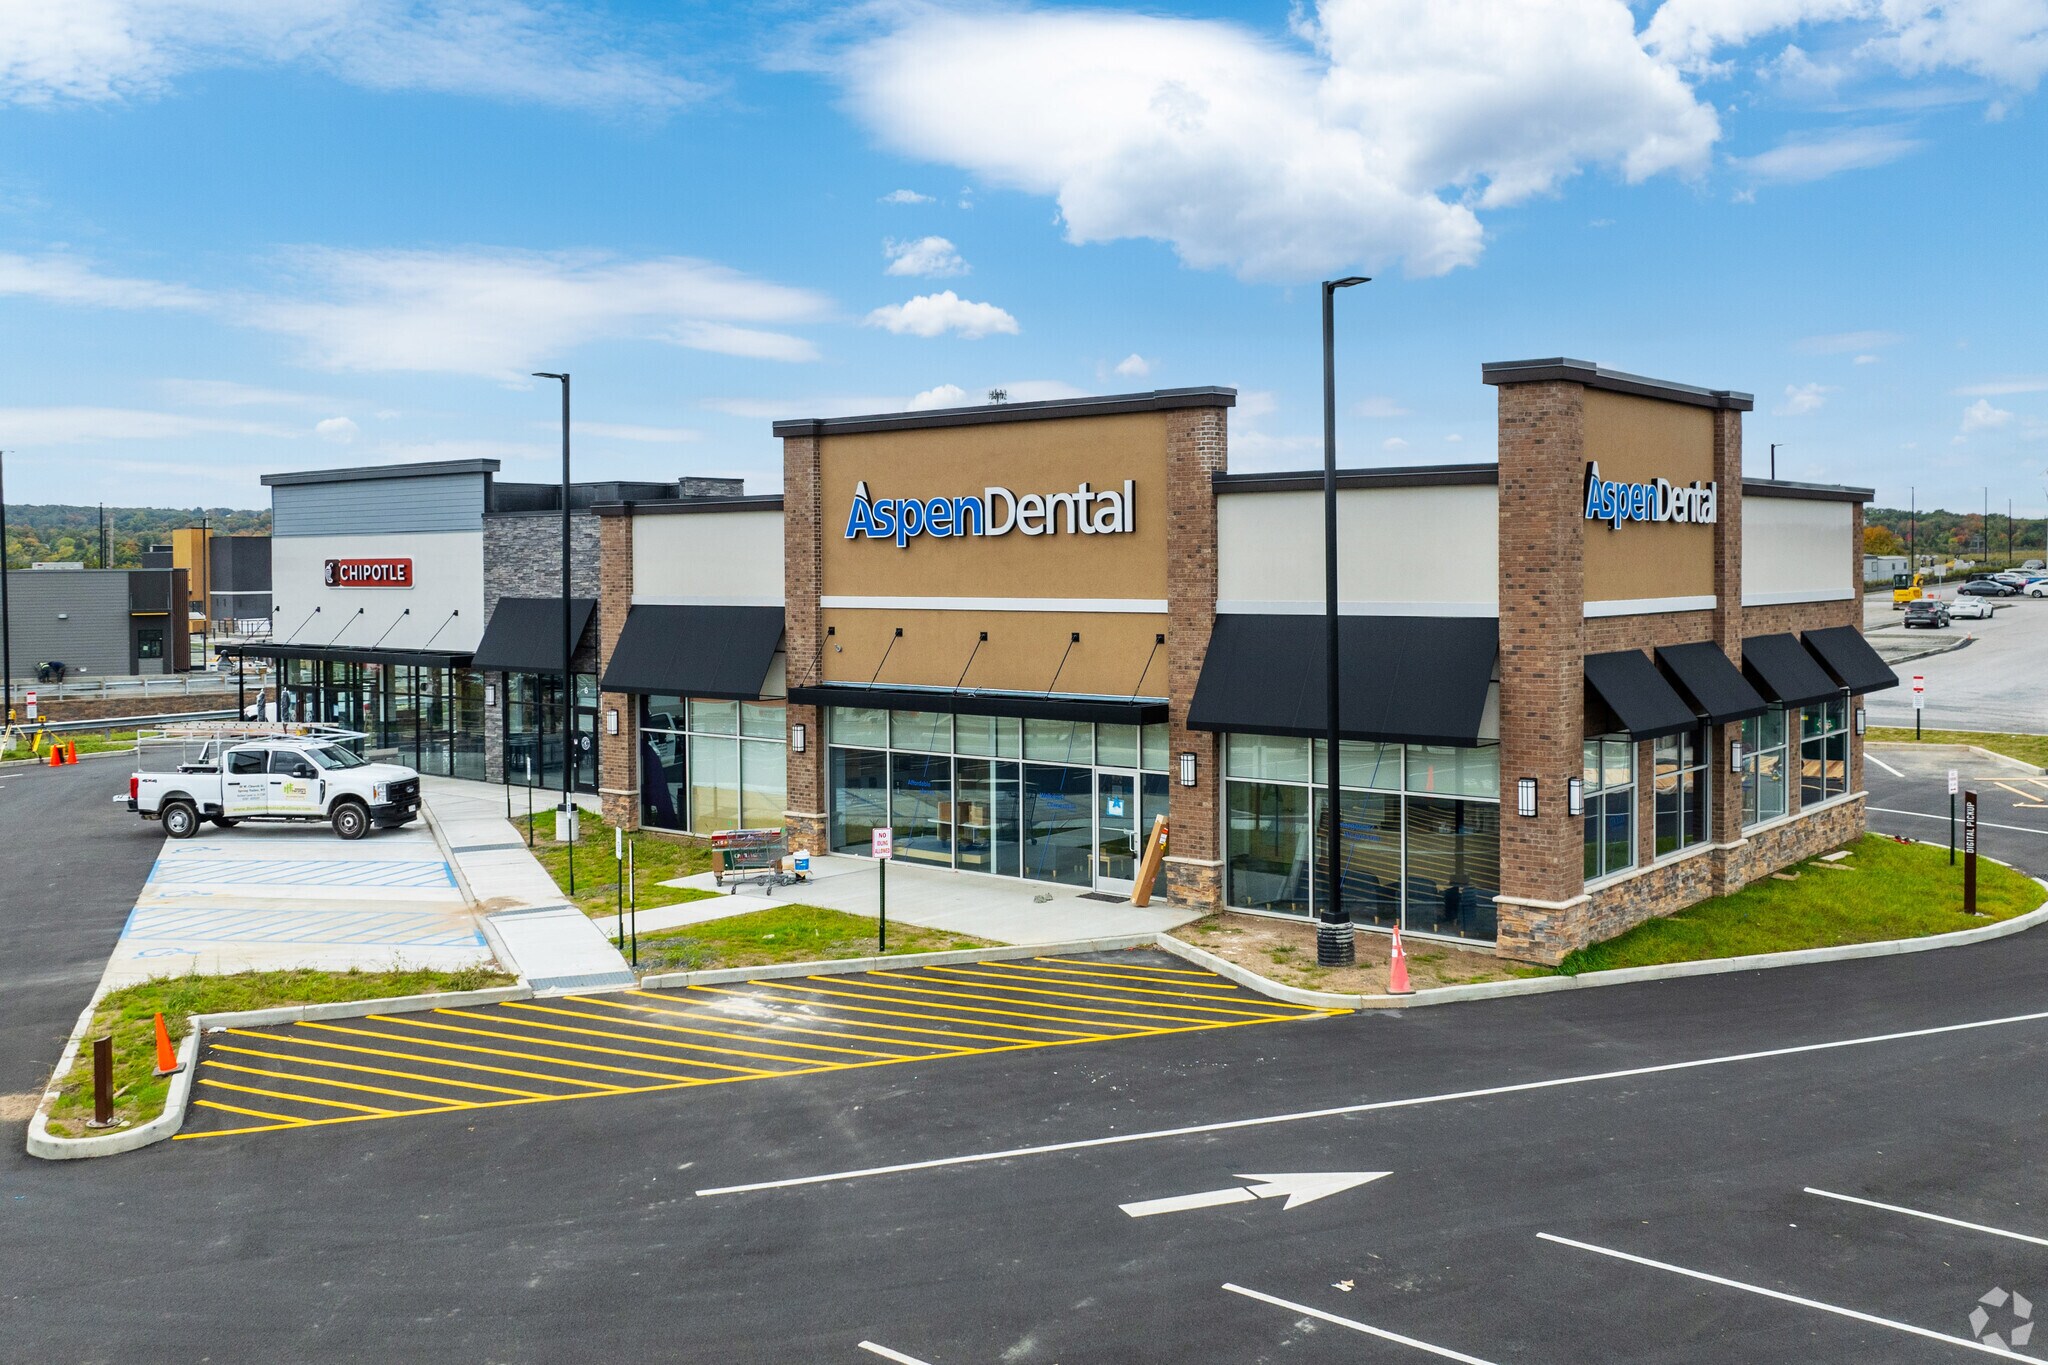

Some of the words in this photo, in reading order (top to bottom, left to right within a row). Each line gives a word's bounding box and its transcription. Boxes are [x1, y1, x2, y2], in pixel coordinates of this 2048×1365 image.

[340, 564, 406, 581] CHIPOTLE
[1966, 802, 1975, 827] PICKUP
[1966, 828, 1975, 854] DIGITAL
